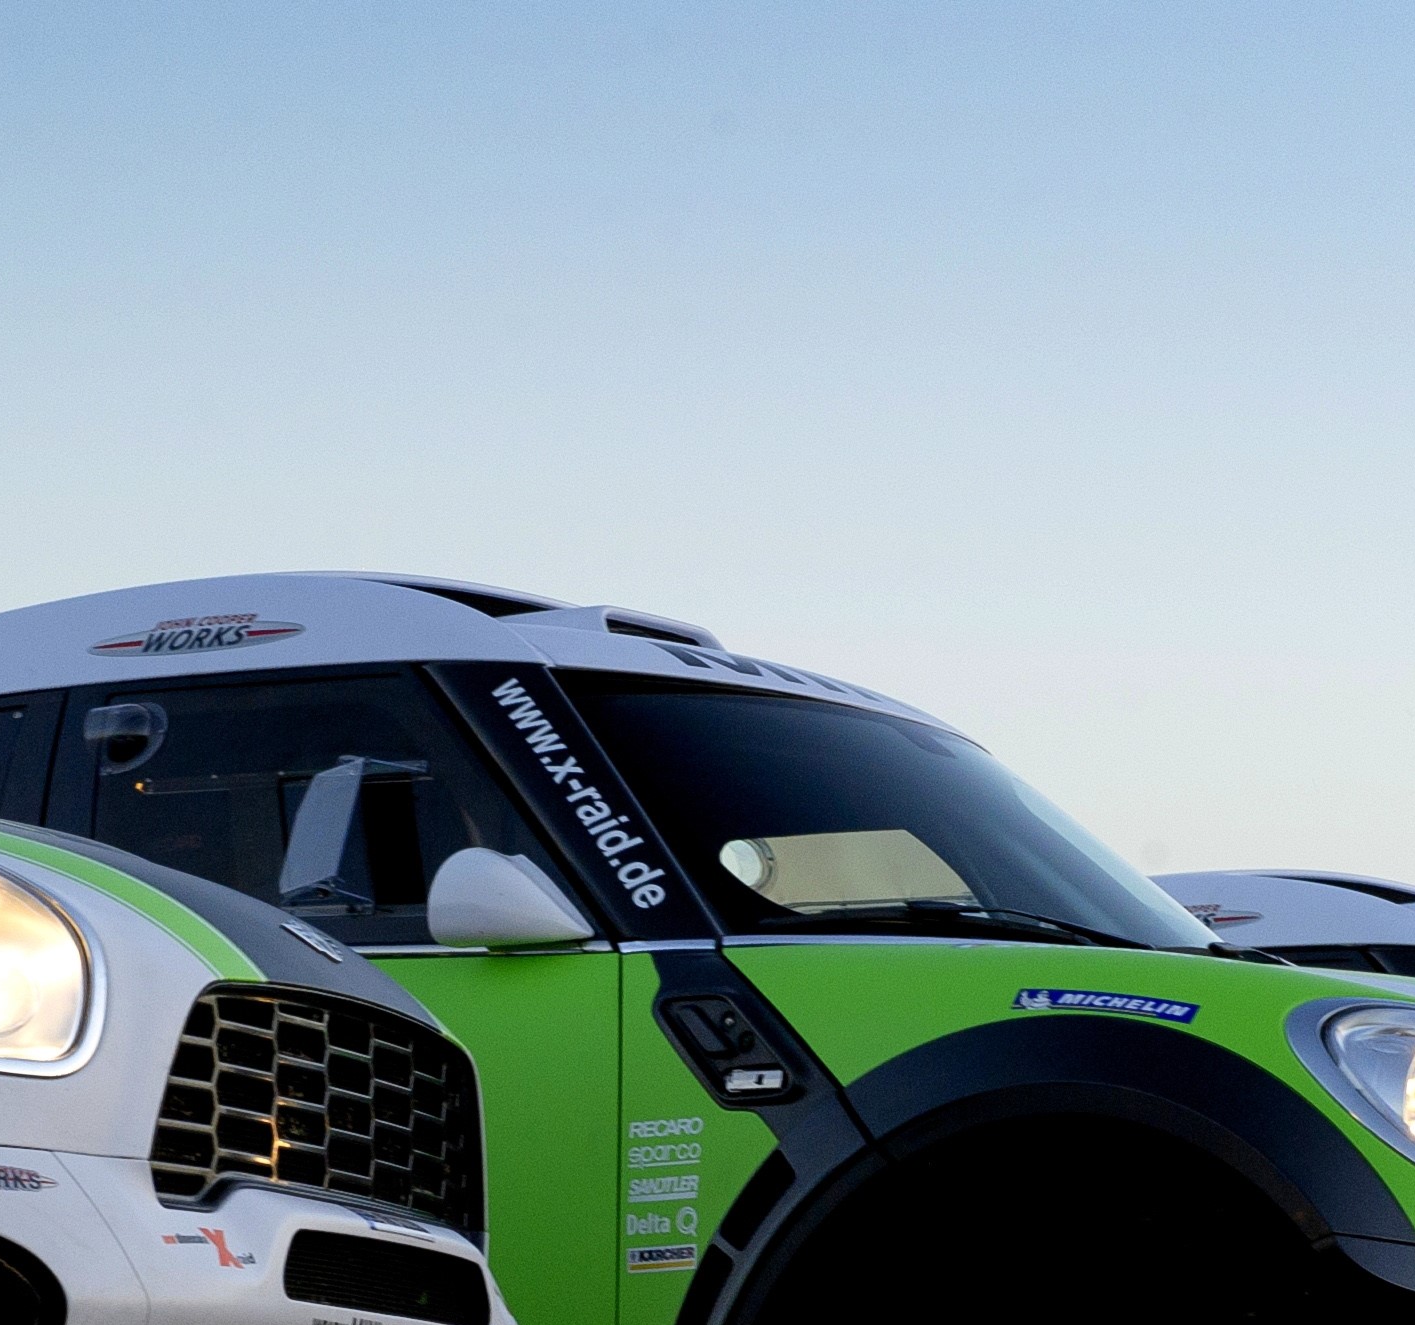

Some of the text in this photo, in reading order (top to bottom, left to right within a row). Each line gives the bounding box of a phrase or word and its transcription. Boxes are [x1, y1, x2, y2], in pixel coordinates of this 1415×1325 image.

[142, 625, 251, 653] WORKS
[491, 677, 667, 909] www.x-raid.de
[1057, 993, 1192, 1018] MICHELIN
[629, 1117, 704, 1138] RECARO
[628, 1142, 703, 1169] sparco
[626, 1206, 698, 1237] Delta Q
